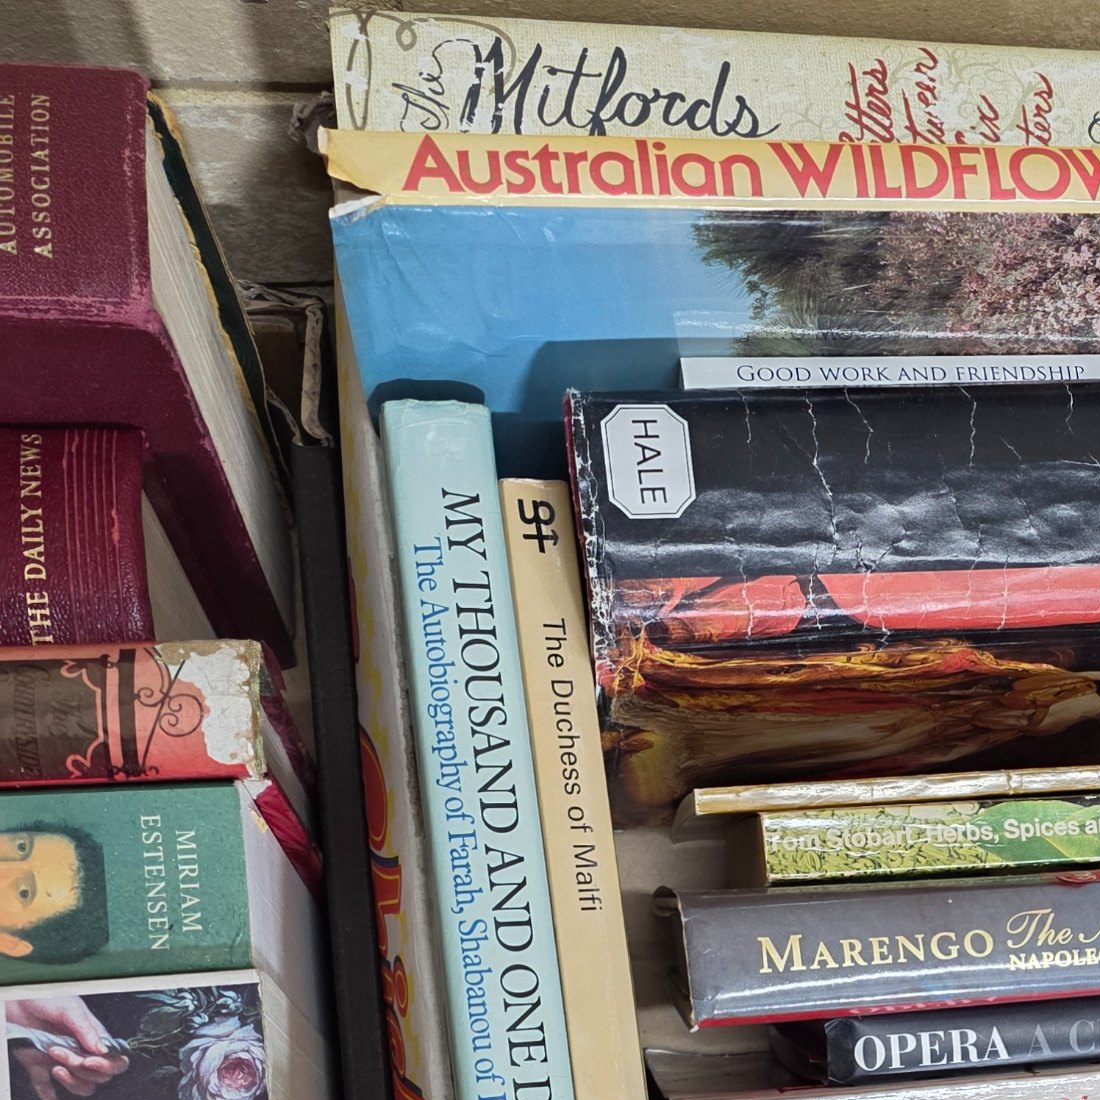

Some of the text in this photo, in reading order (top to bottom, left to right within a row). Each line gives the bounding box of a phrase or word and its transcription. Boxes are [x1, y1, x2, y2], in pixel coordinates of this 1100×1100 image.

[459, 36, 781, 137] Mitfords
[30, 94, 53, 259] ASSOCIATION
[402, 135, 764, 197] Australian
[737, 364, 1086, 382] GOOD WORK AND FRIENDSHIP
[632, 418, 668, 504] HALE
[19, 434, 54, 645] THE DAILY NEWS
[413, 536, 443, 591] The
[442, 487, 488, 562] MY
[419, 598, 470, 792] Autobiography
[452, 570, 521, 834] THOUSAND
[542, 618, 603, 912] The Duchess of Malfi
[447, 795, 477, 831] of
[926, 819, 1000, 845] Herbs,
[1003, 813, 1080, 841] Spices
[140, 815, 170, 950] ESTENSEN
[175, 829, 202, 932] MIRIAM
[448, 831, 484, 914] Farah,
[485, 843, 534, 953] AND
[458, 919, 494, 1053] Shabanou
[757, 930, 994, 974] MARENGO
[1006, 907, 1073, 950] The
[500, 963, 549, 1067] ONE
[854, 1026, 1012, 1071] OPERA
[1027, 1022, 1052, 1056] A
[475, 1057, 507, 1090] of
